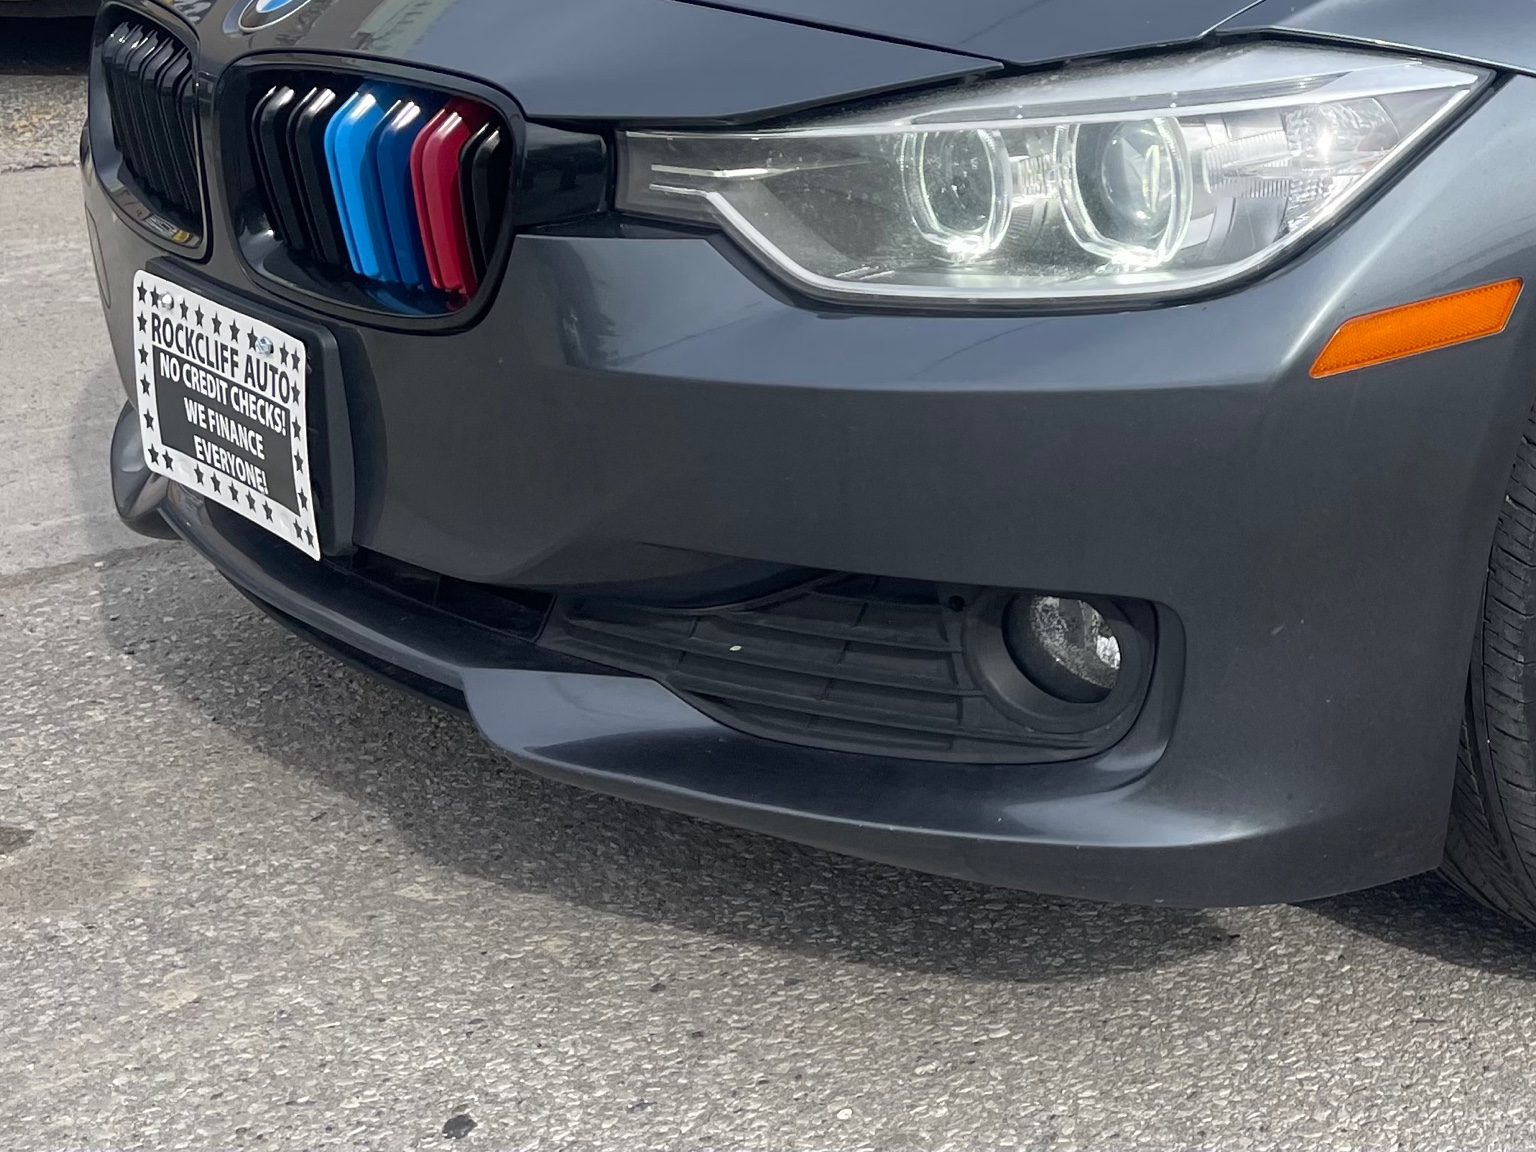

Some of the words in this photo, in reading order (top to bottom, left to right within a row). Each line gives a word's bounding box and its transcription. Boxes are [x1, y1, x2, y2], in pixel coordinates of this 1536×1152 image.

[151, 311, 239, 378] ROCKCLIFF
[244, 353, 290, 404] AUTO
[160, 351, 181, 382] NO
[182, 363, 228, 405] CREDIT
[230, 385, 286, 436] CHECKS!
[183, 397, 207, 429] WE
[207, 408, 265, 460] FINANCE
[193, 434, 269, 495] EVERYONE!
